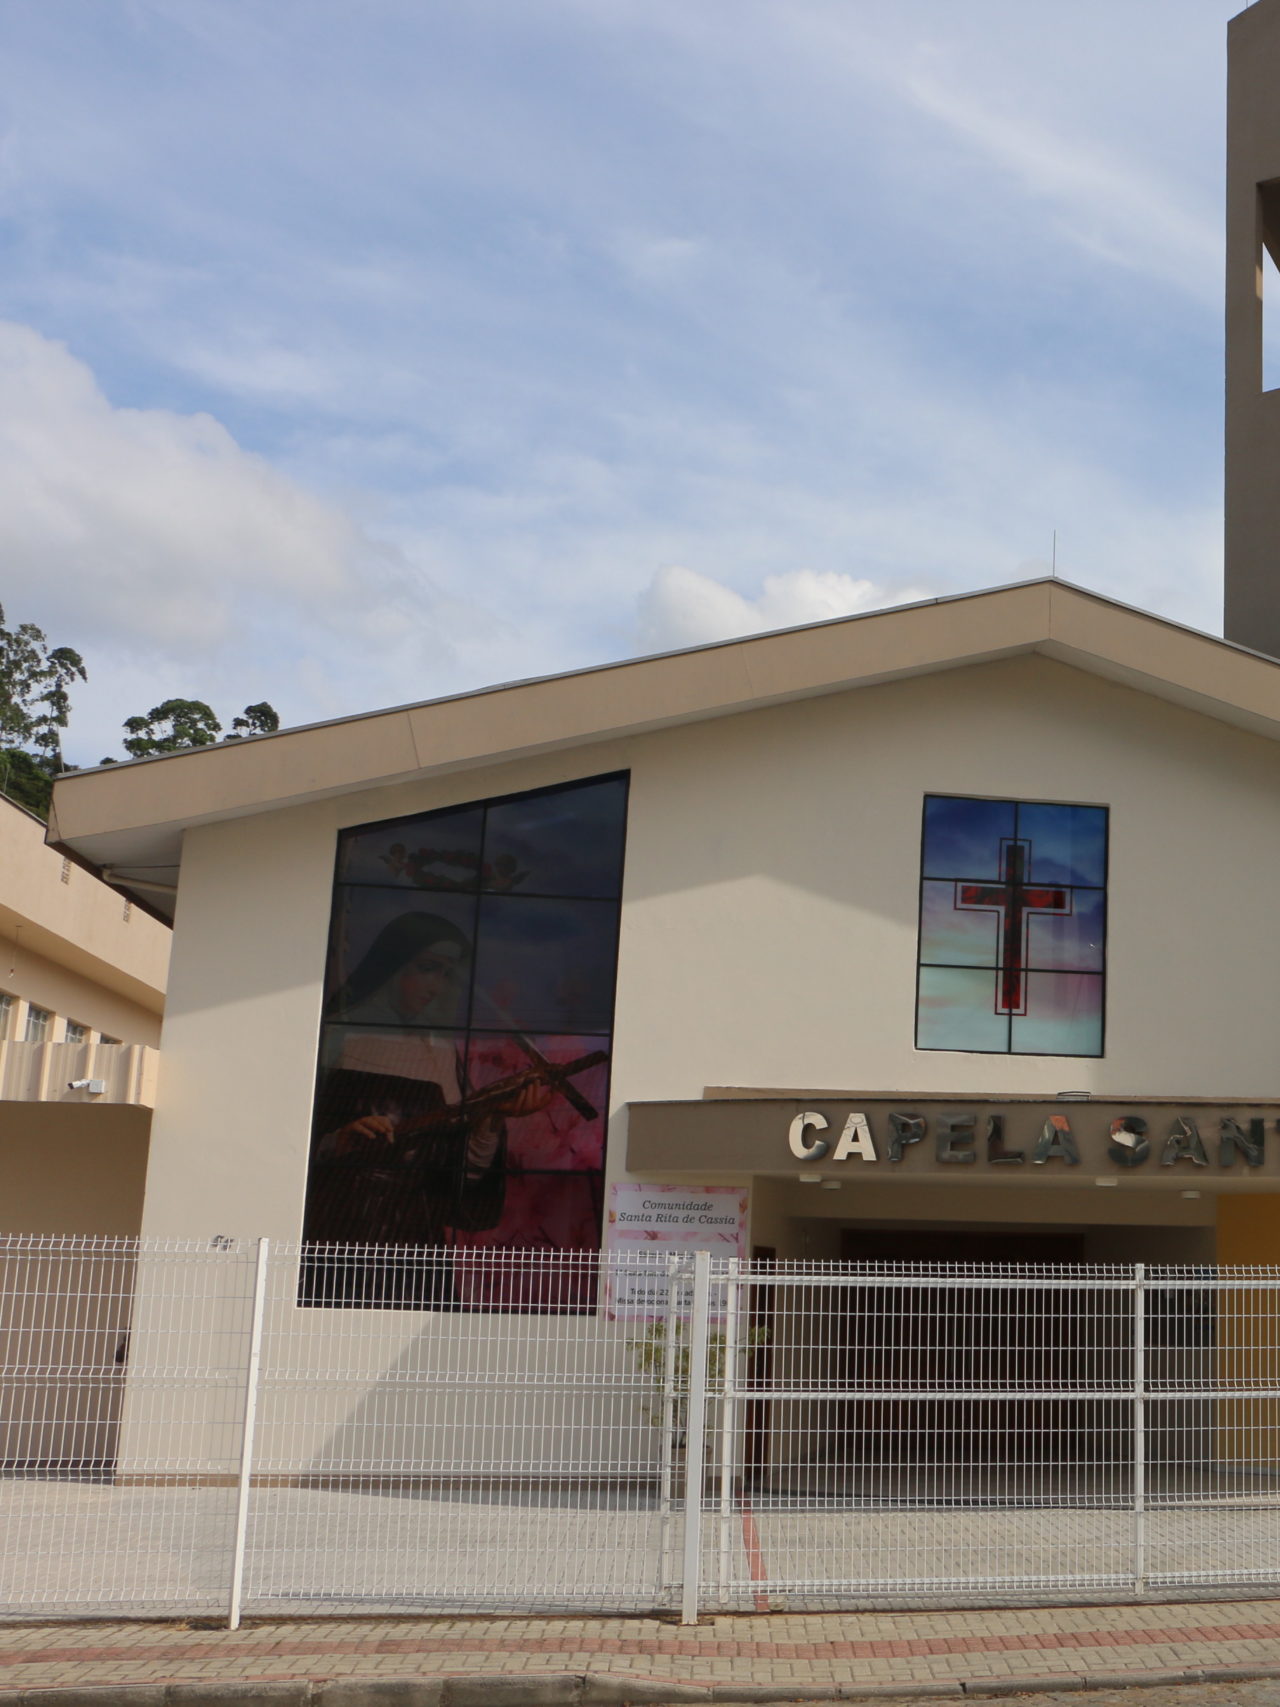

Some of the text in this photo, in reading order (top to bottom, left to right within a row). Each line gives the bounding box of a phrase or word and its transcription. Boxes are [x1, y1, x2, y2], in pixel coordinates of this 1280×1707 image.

[788, 1111, 1082, 1166] CAPELA
[642, 1200, 714, 1211] Comunidade
[619, 1213, 736, 1225] Santa Rita de Cassia
